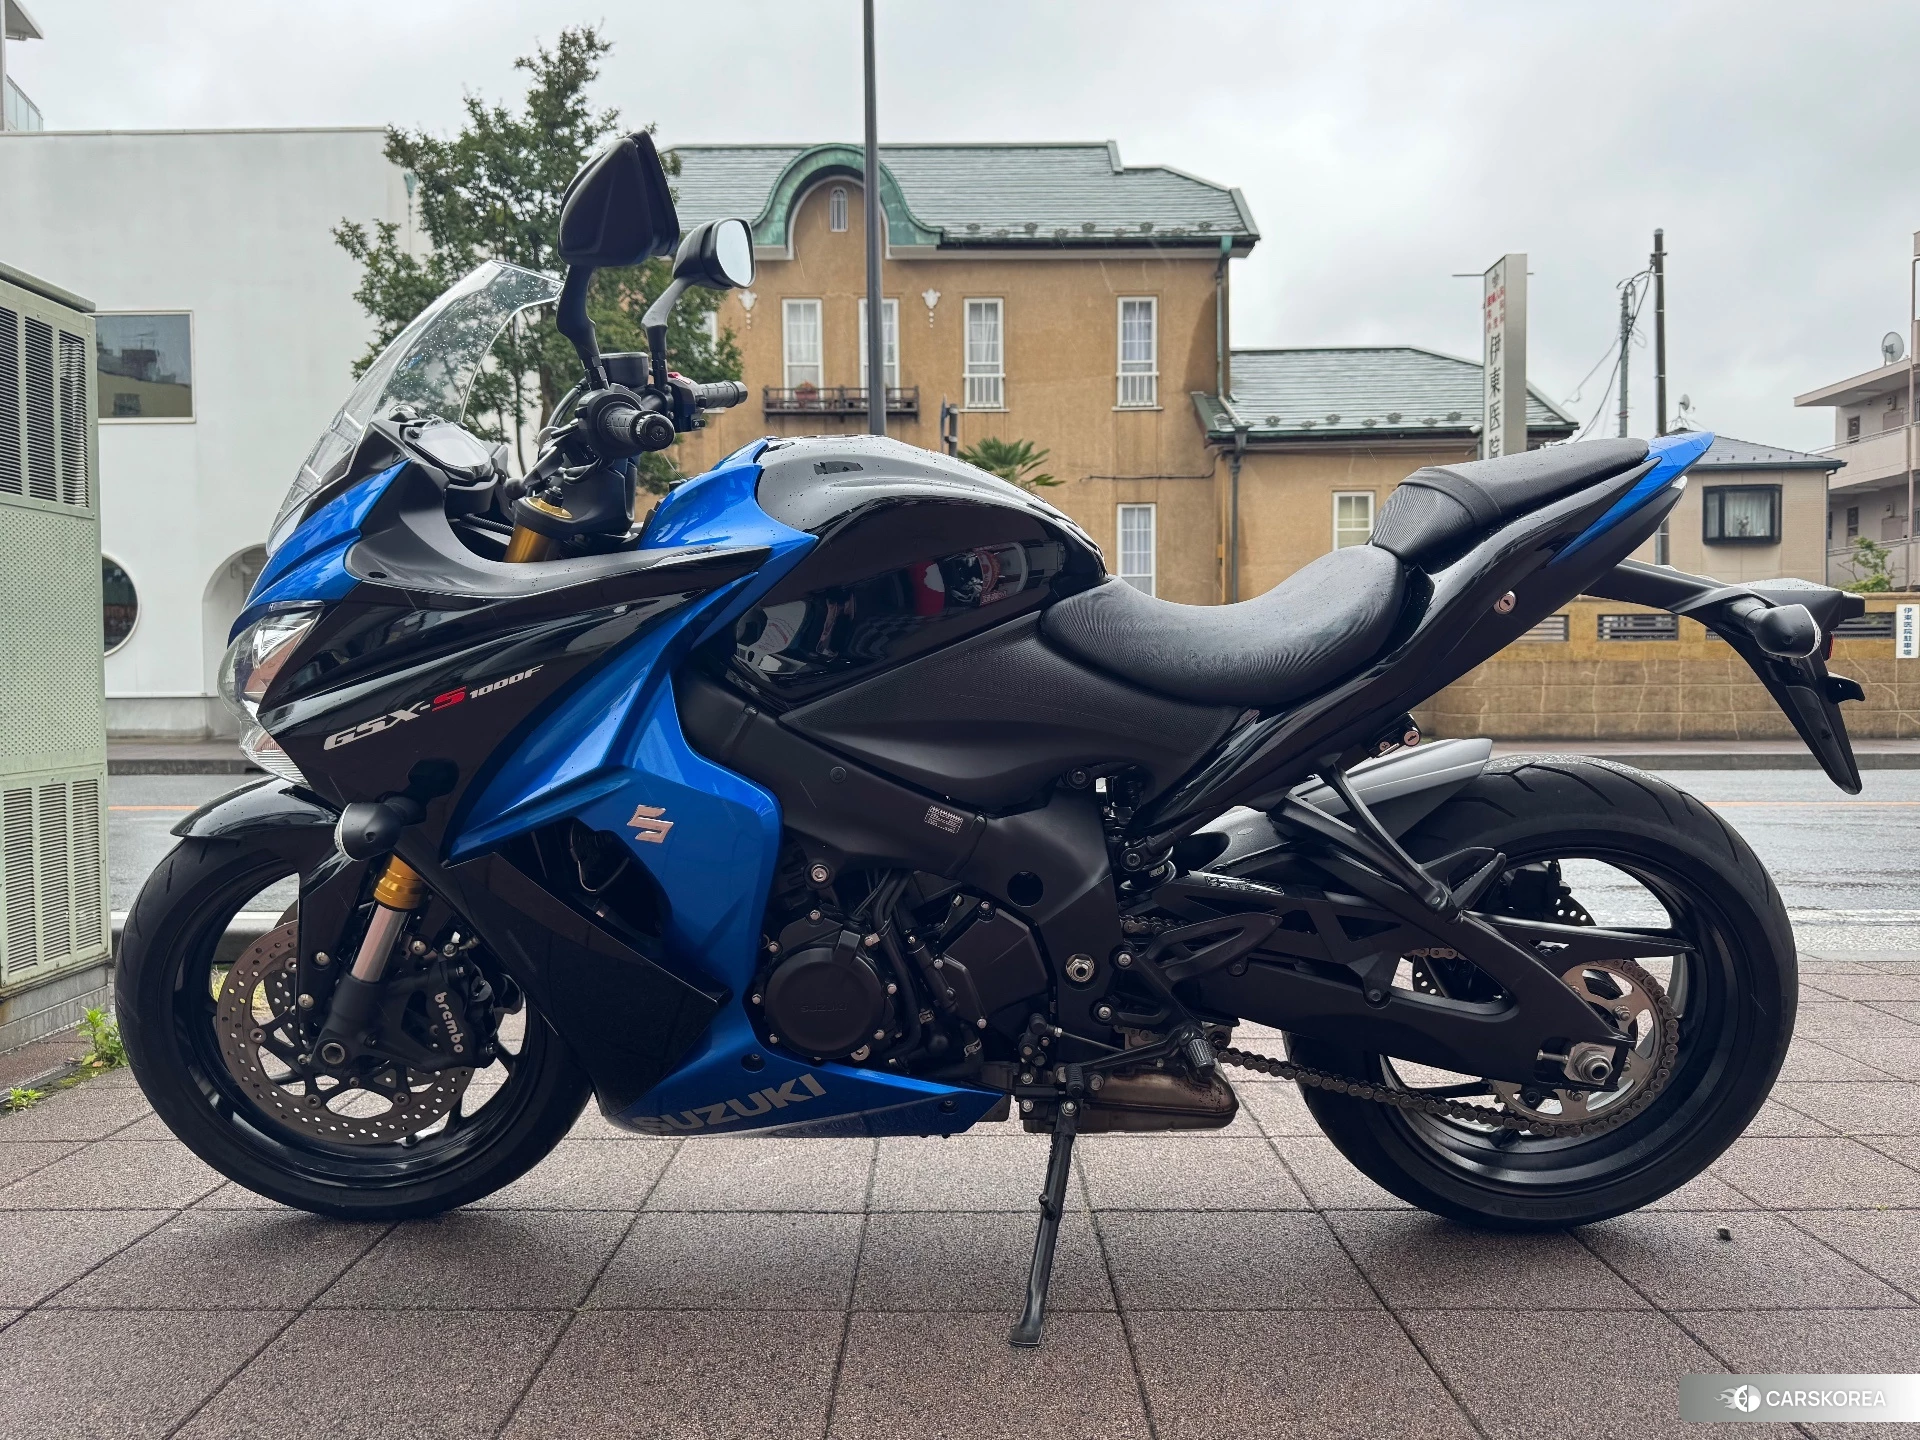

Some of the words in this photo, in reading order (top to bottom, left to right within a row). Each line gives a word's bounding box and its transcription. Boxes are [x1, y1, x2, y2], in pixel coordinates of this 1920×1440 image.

[323, 686, 467, 751] GSX-S
[469, 664, 544, 699] 1000F
[434, 991, 464, 1053] brembo
[632, 1073, 827, 1133] SUZUKI
